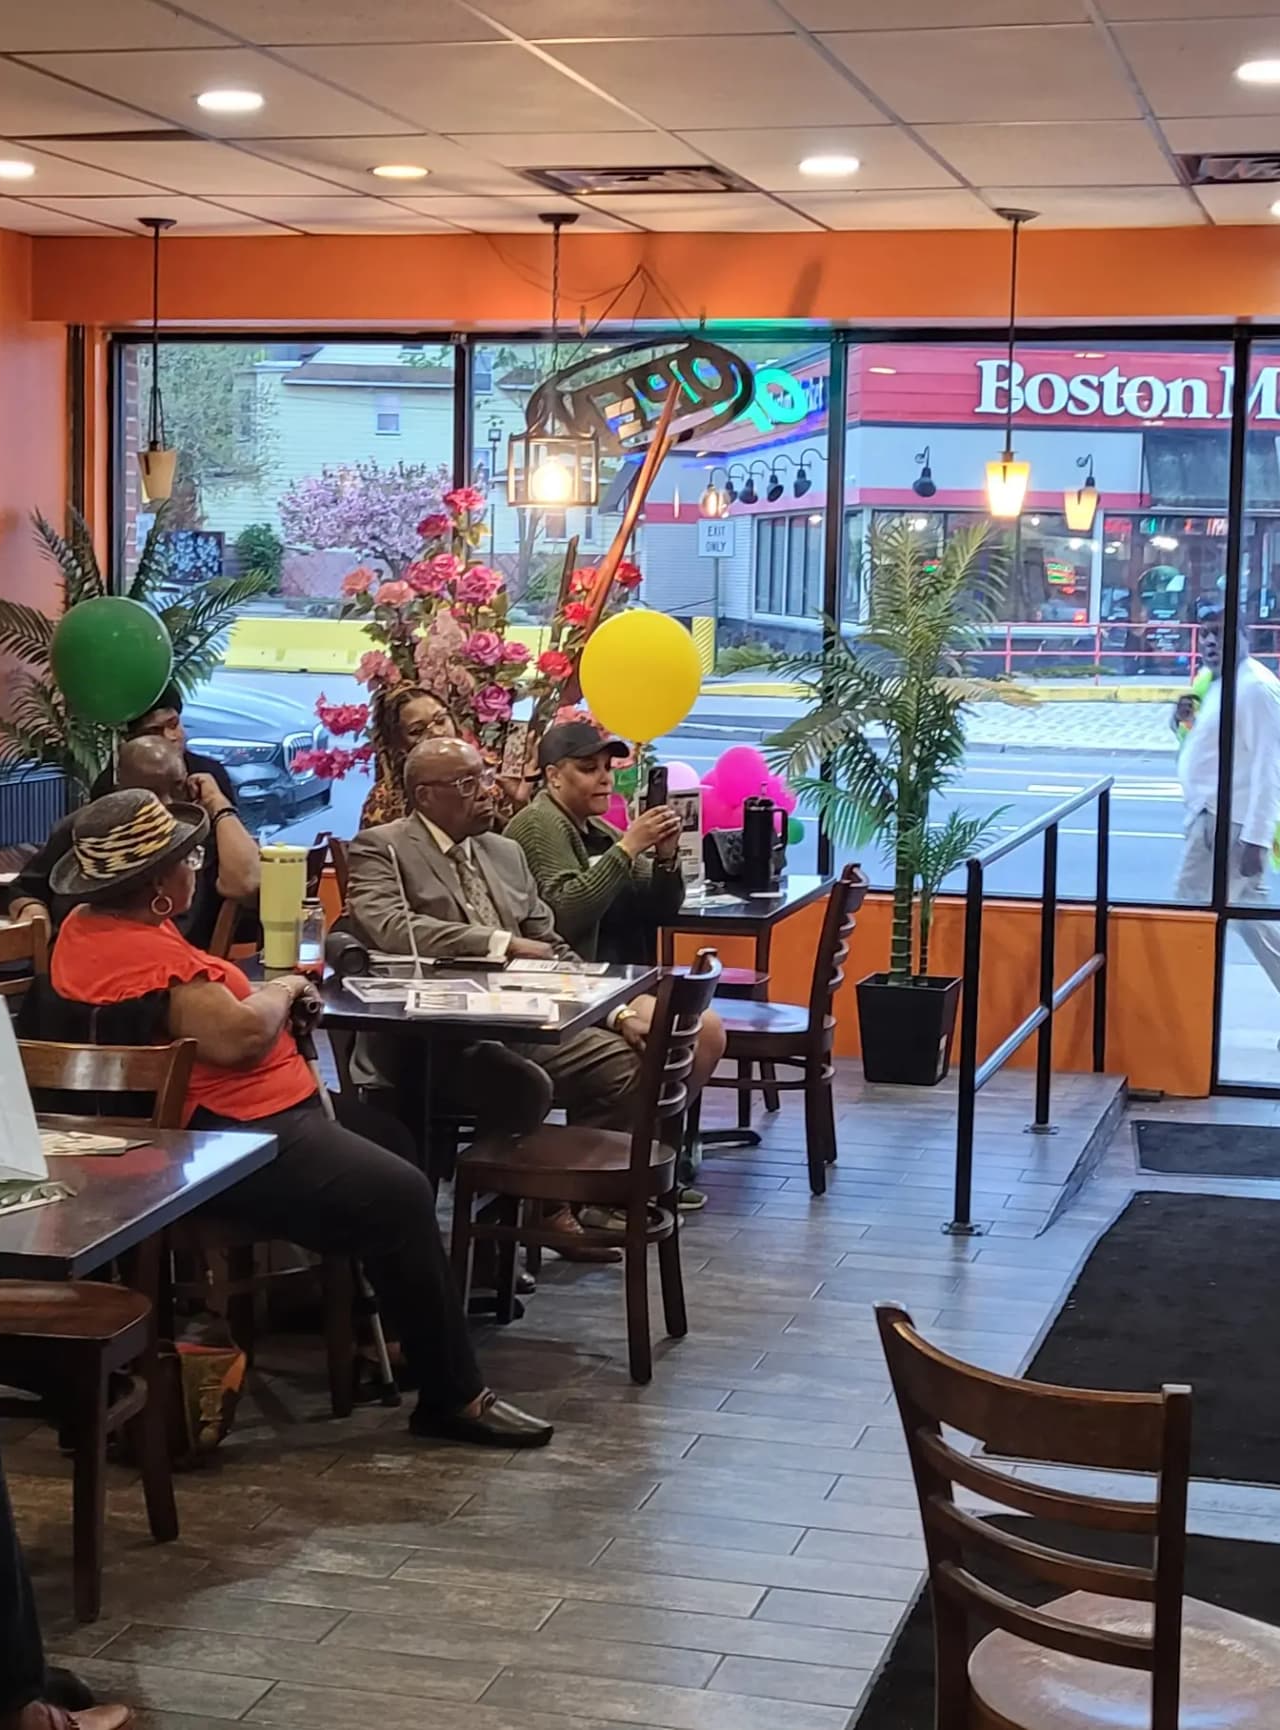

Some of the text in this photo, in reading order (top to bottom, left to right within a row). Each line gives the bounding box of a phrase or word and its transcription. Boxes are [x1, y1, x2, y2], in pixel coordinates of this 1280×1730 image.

[974, 358, 1211, 419] Boston
[707, 525, 726, 537] EXIT
[705, 541, 727, 553] ONLY
